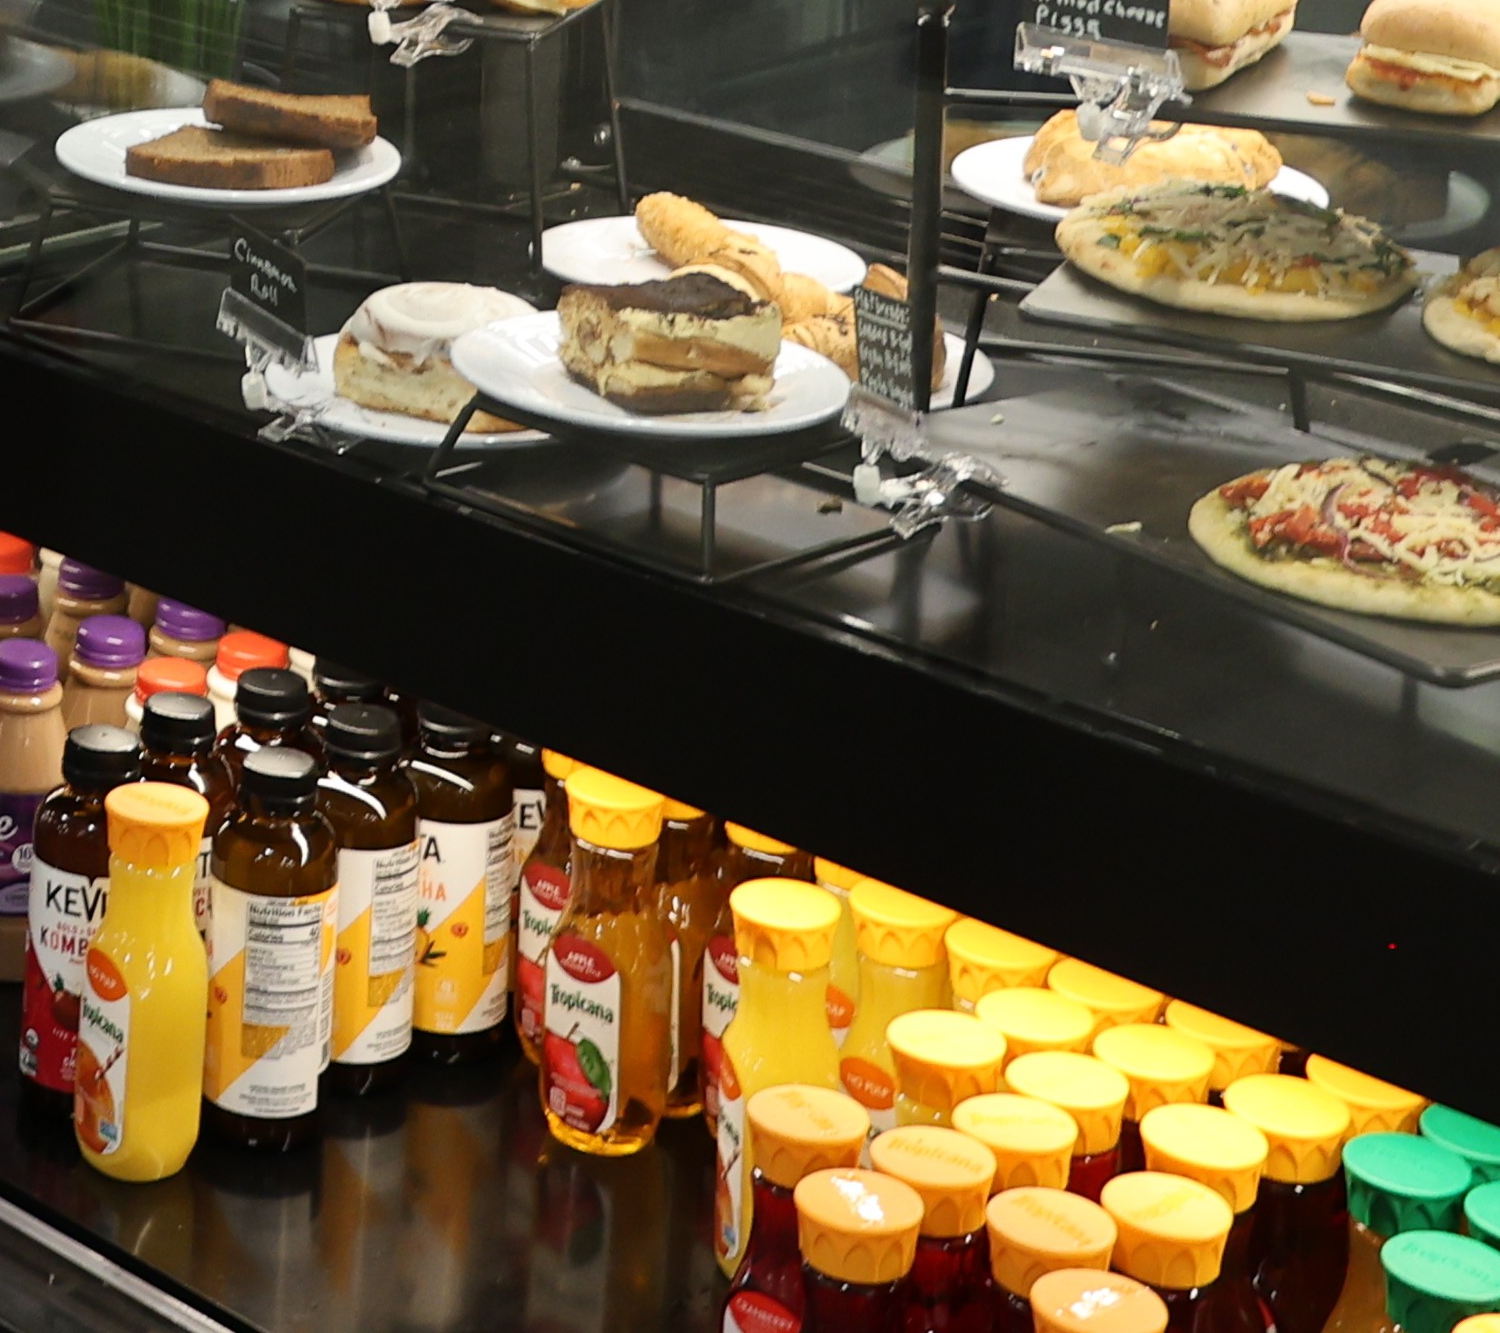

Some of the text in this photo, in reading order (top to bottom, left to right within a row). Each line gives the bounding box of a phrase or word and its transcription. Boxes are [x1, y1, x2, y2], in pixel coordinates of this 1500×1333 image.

[251, 272, 278, 306] Roll
[249, 903, 295, 917] Nutrition
[567, 950, 595, 970] APPLE
[83, 996, 124, 1044] Tropicana
[551, 983, 614, 1024] Tropicana
[846, 1073, 891, 1098] NO PULP
[736, 1297, 794, 1332] CRANBERRY
